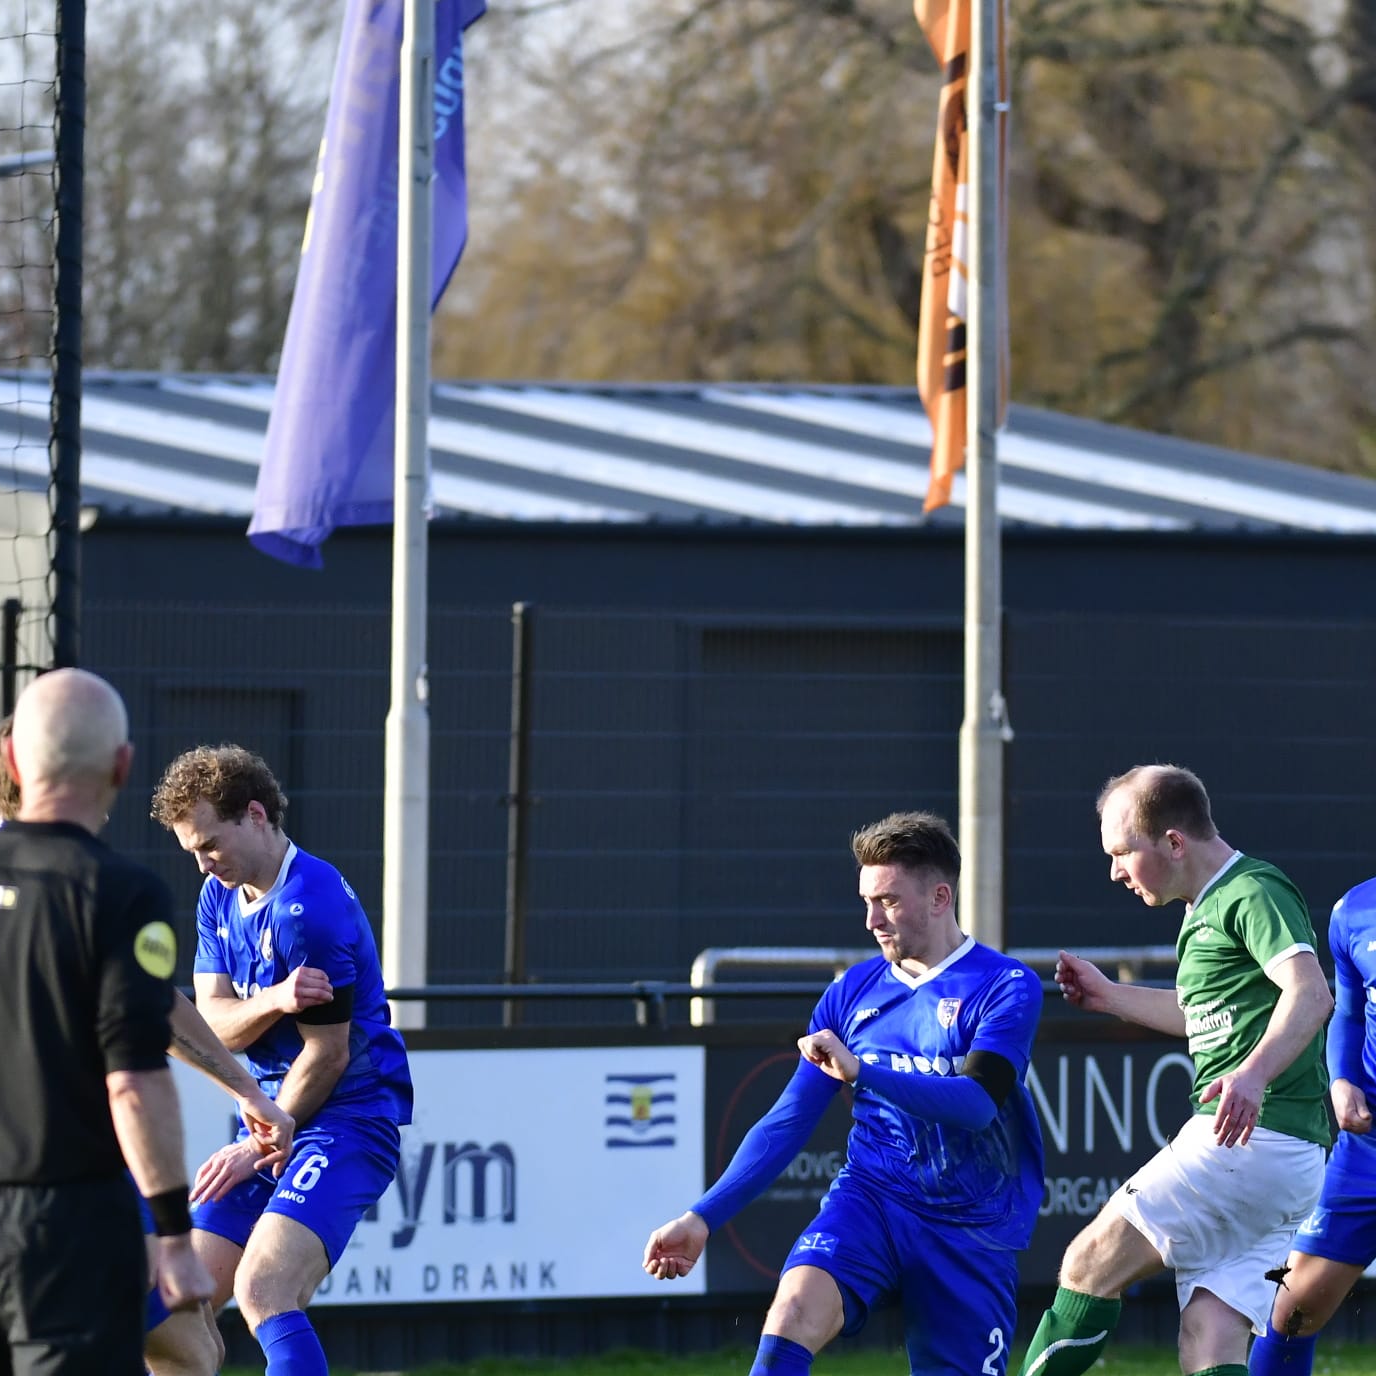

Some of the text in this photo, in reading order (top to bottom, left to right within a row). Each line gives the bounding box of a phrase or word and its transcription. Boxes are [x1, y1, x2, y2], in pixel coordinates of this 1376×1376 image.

[292, 1154, 329, 1191] 6
[277, 1189, 305, 1204] JAKO
[362, 1138, 517, 1249] ym
[424, 1260, 559, 1294] DRANK
[982, 1327, 1004, 1376] 2
